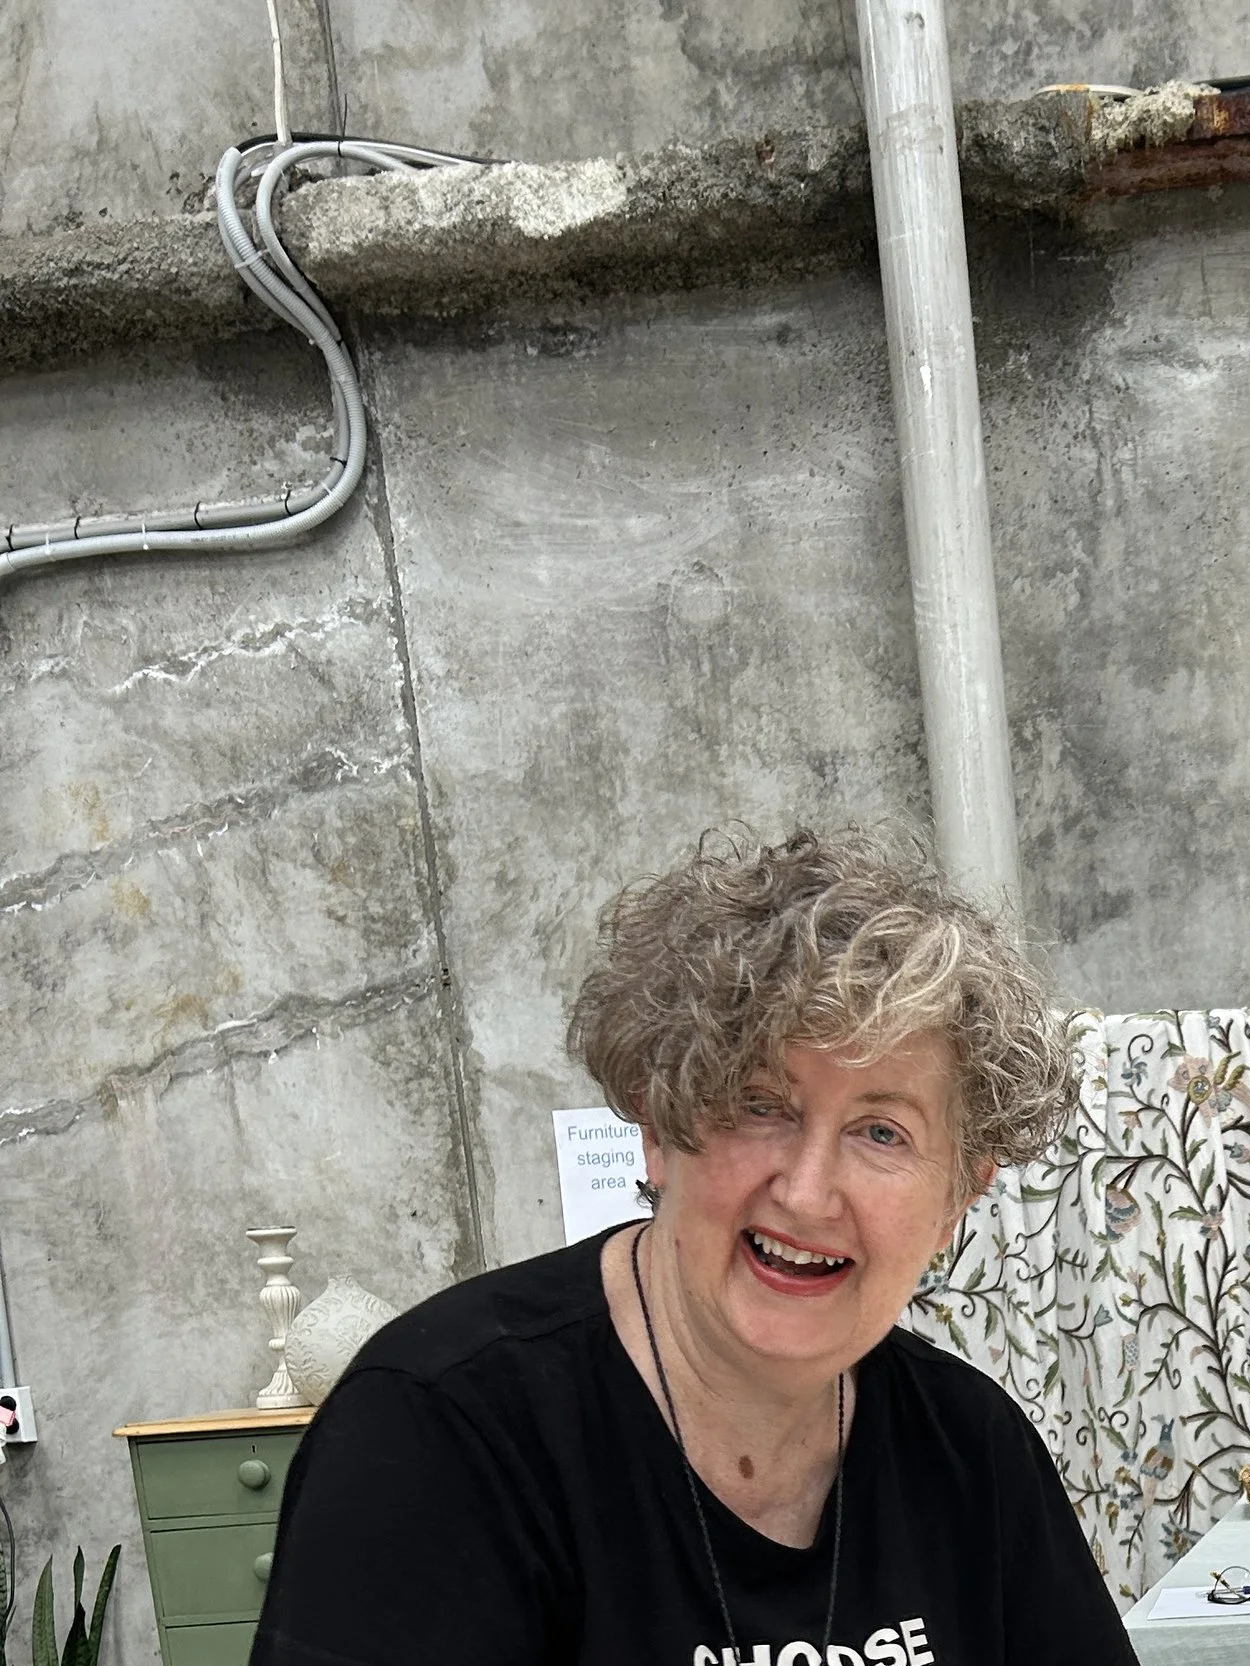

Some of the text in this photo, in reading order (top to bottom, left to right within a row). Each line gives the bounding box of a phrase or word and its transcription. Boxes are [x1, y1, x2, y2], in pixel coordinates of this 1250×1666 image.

[567, 1124, 639, 1141] Furniture
[577, 1150, 635, 1168] staging
[591, 1176, 626, 1190] area
